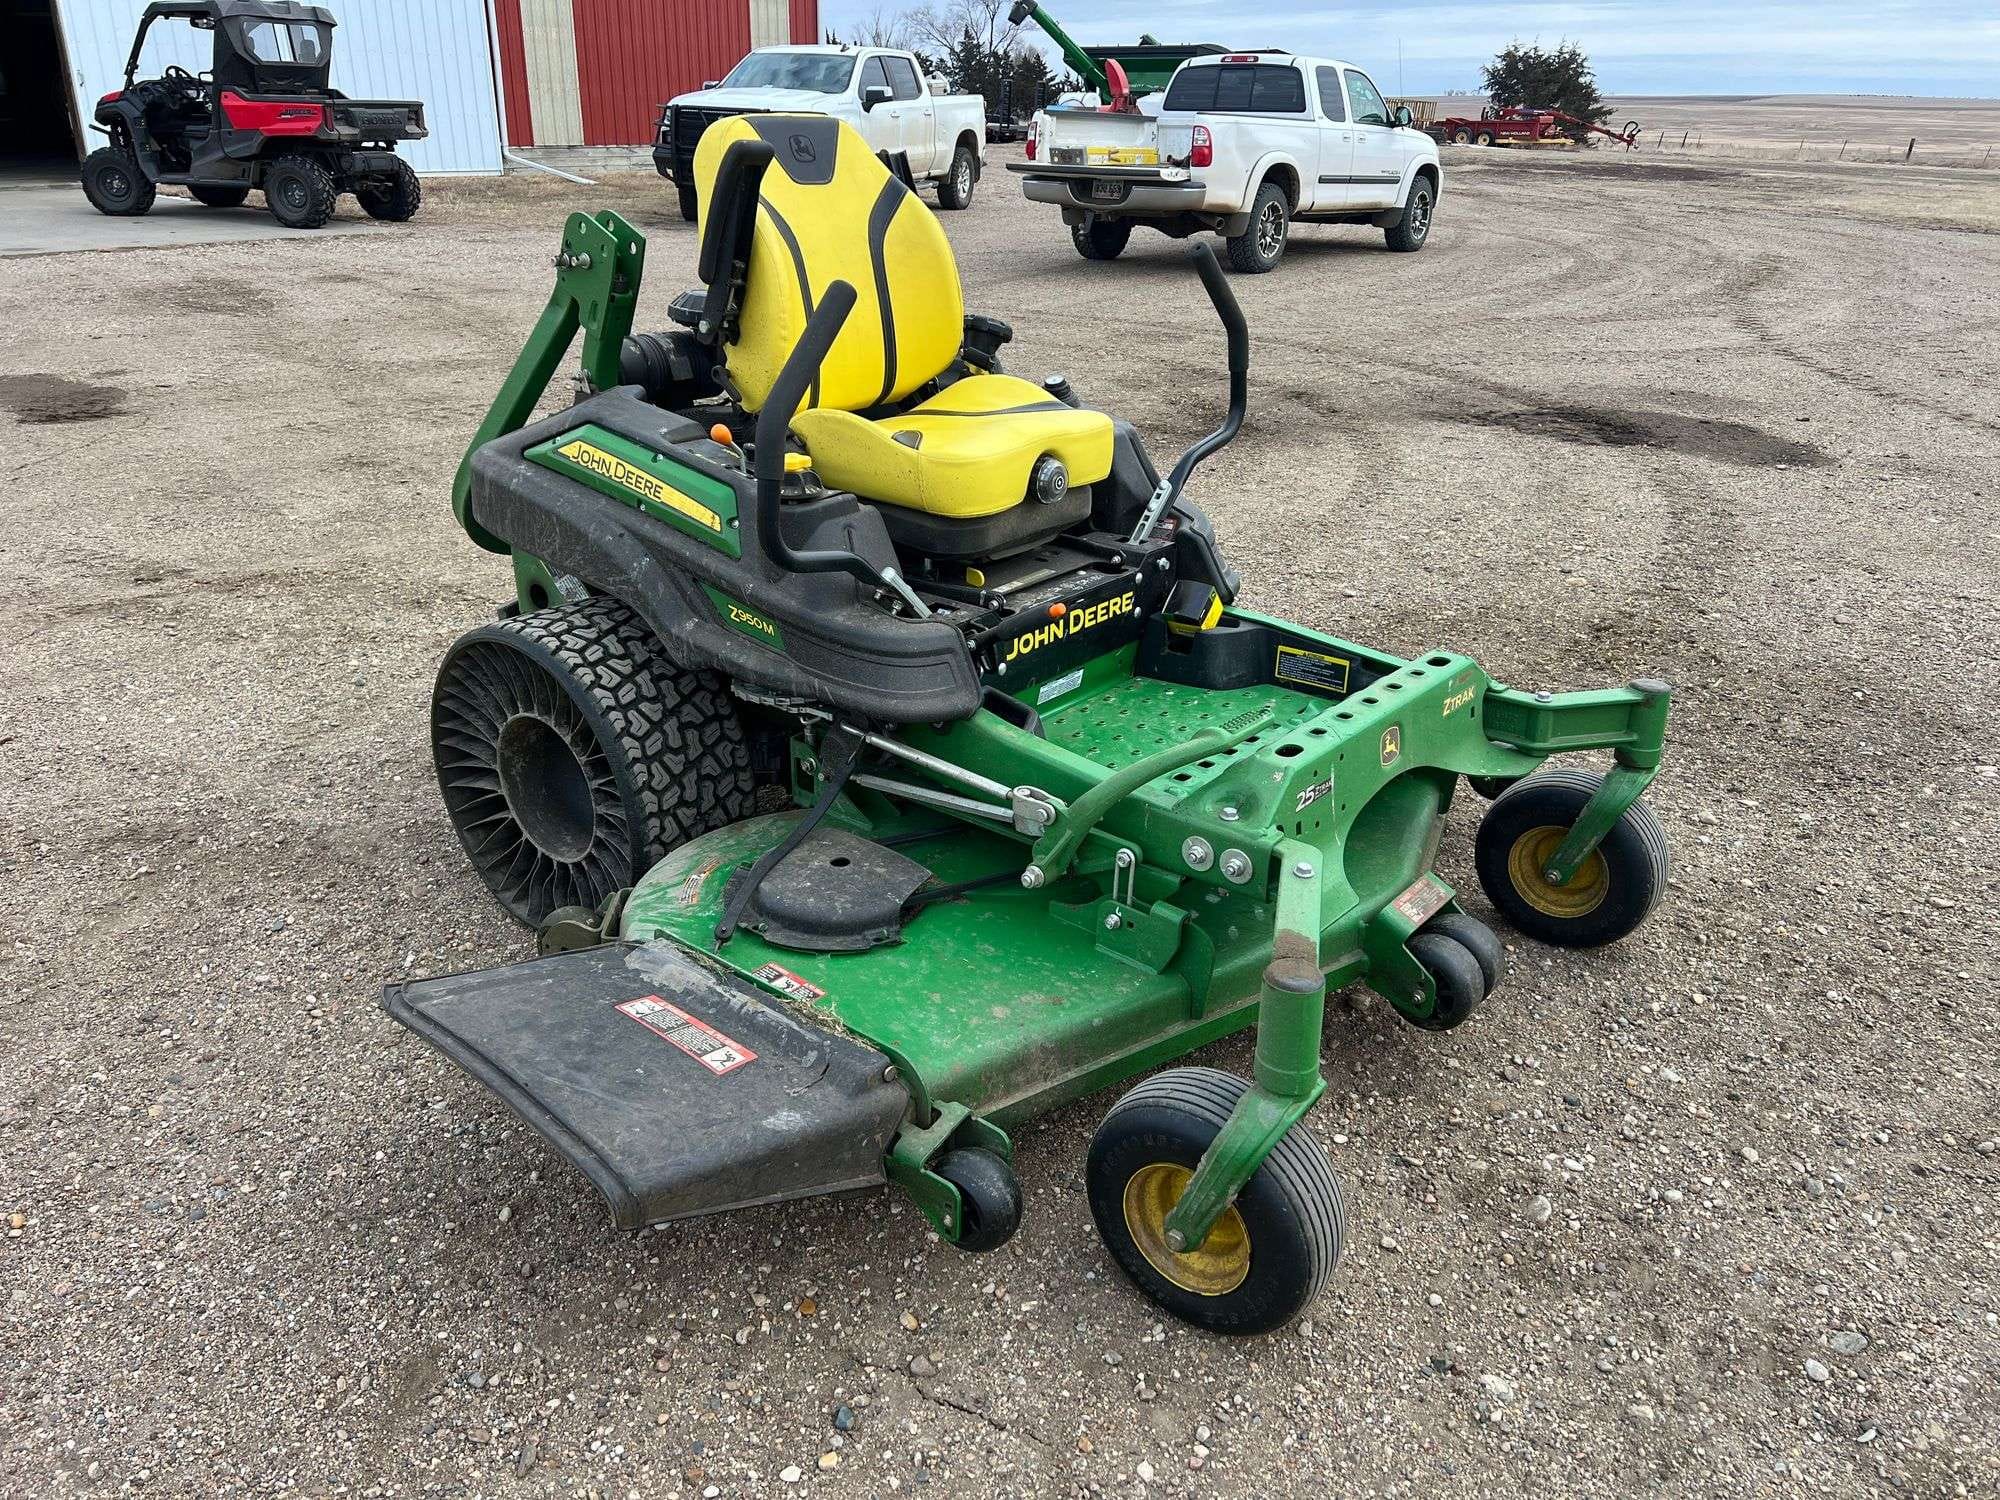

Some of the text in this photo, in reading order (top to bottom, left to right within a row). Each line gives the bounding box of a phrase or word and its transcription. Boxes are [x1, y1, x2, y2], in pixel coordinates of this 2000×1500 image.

[572, 444, 664, 500] JOHN DEERE
[728, 604, 775, 637] Z950M
[1006, 591, 1134, 661] JOHN DEERE
[1442, 685, 1475, 717] ZTRAK
[1295, 784, 1315, 813] 25
